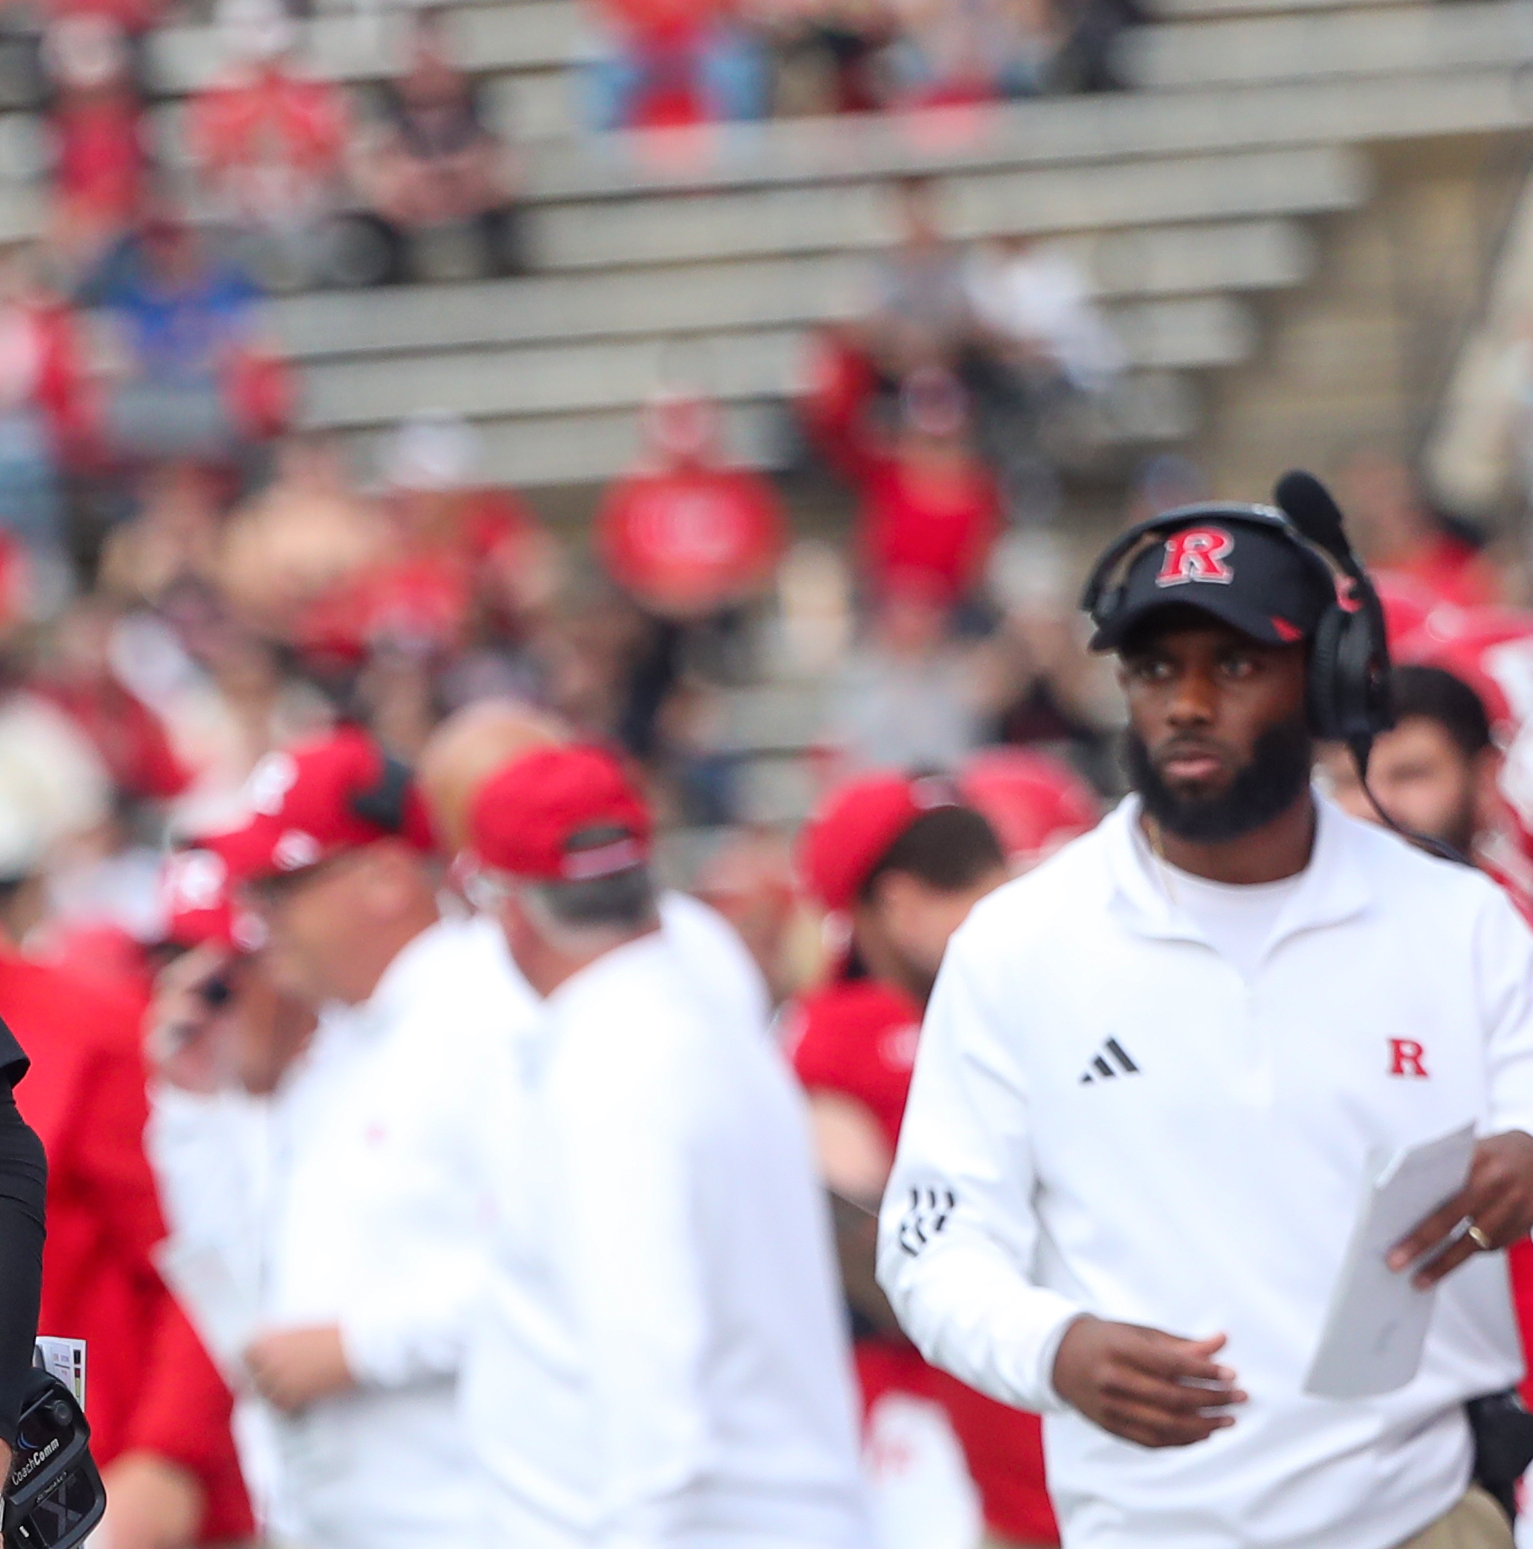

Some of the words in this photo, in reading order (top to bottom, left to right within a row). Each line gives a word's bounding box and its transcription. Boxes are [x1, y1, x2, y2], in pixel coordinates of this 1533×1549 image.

[1155, 526, 1233, 588] R
[1388, 1037, 1429, 1077] R
[11, 1438, 60, 1486] CoachComm
